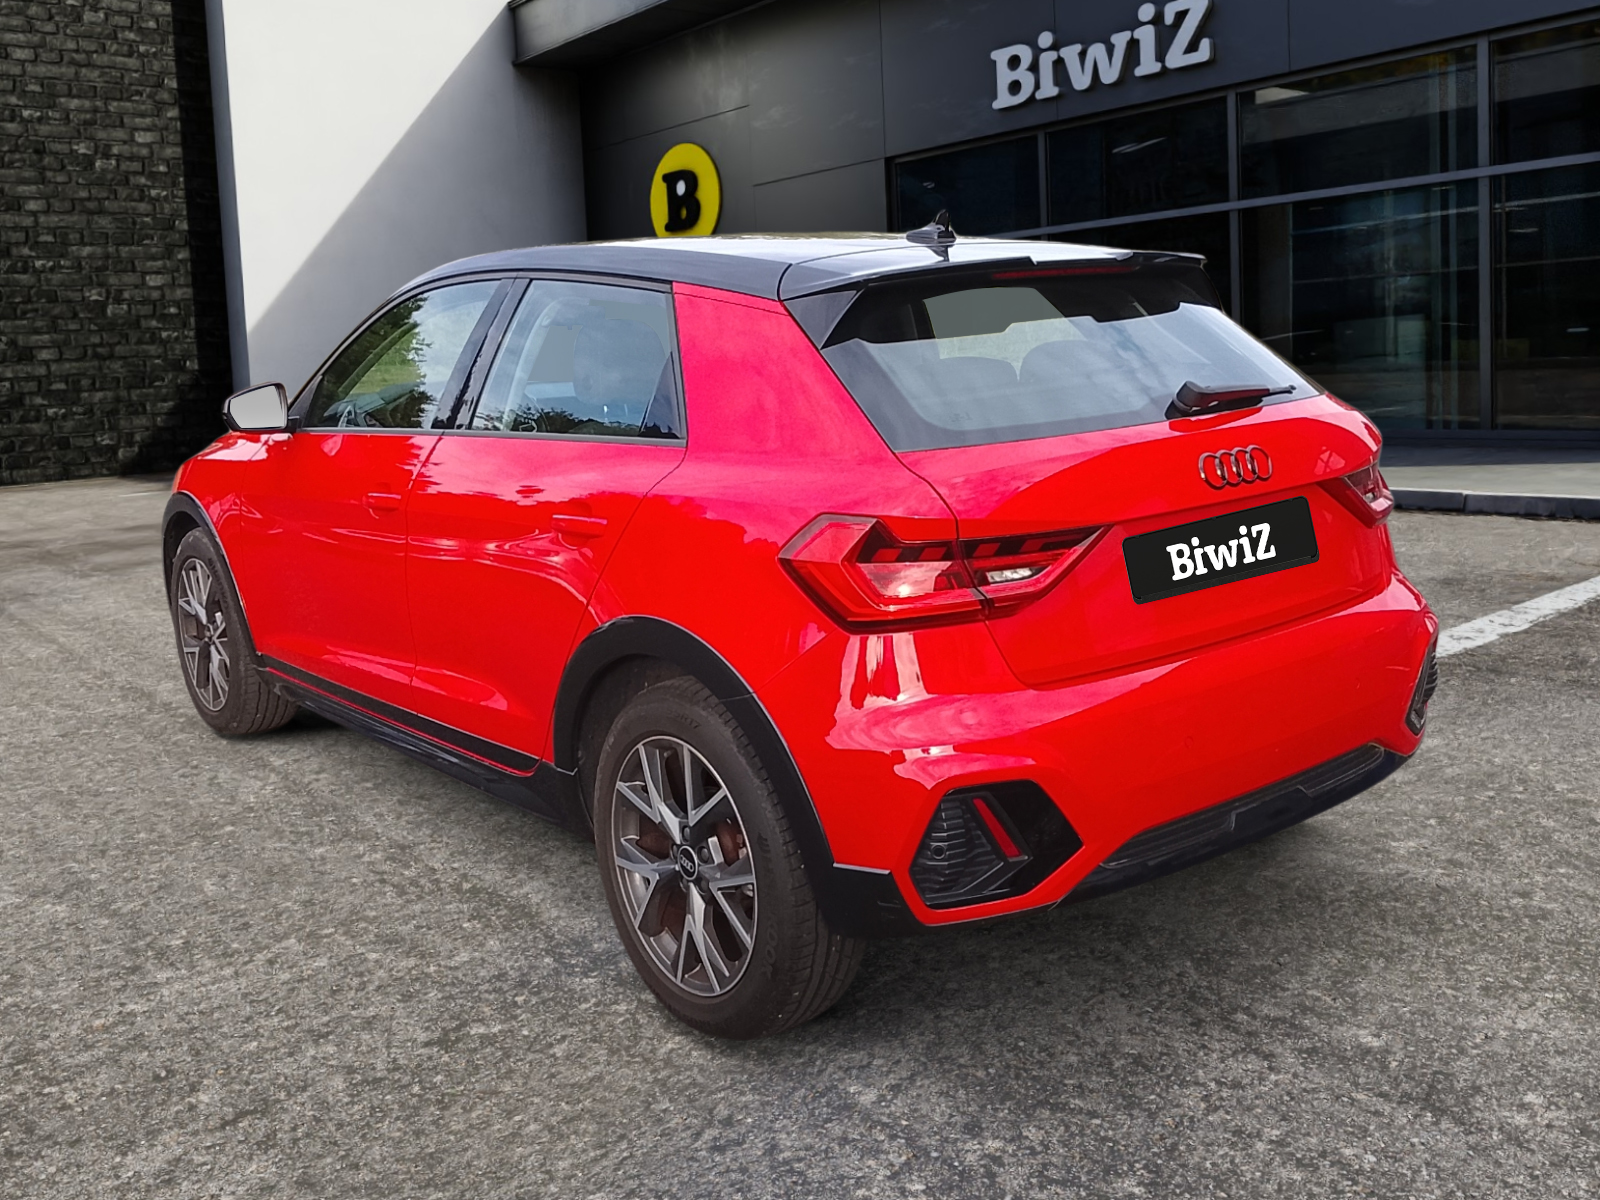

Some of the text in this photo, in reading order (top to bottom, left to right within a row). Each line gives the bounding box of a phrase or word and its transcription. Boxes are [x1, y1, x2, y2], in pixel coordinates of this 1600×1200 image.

[990, 0, 1212, 110] BiwiZ
[661, 169, 701, 233] B
[1166, 522, 1276, 581] BiwiZ
